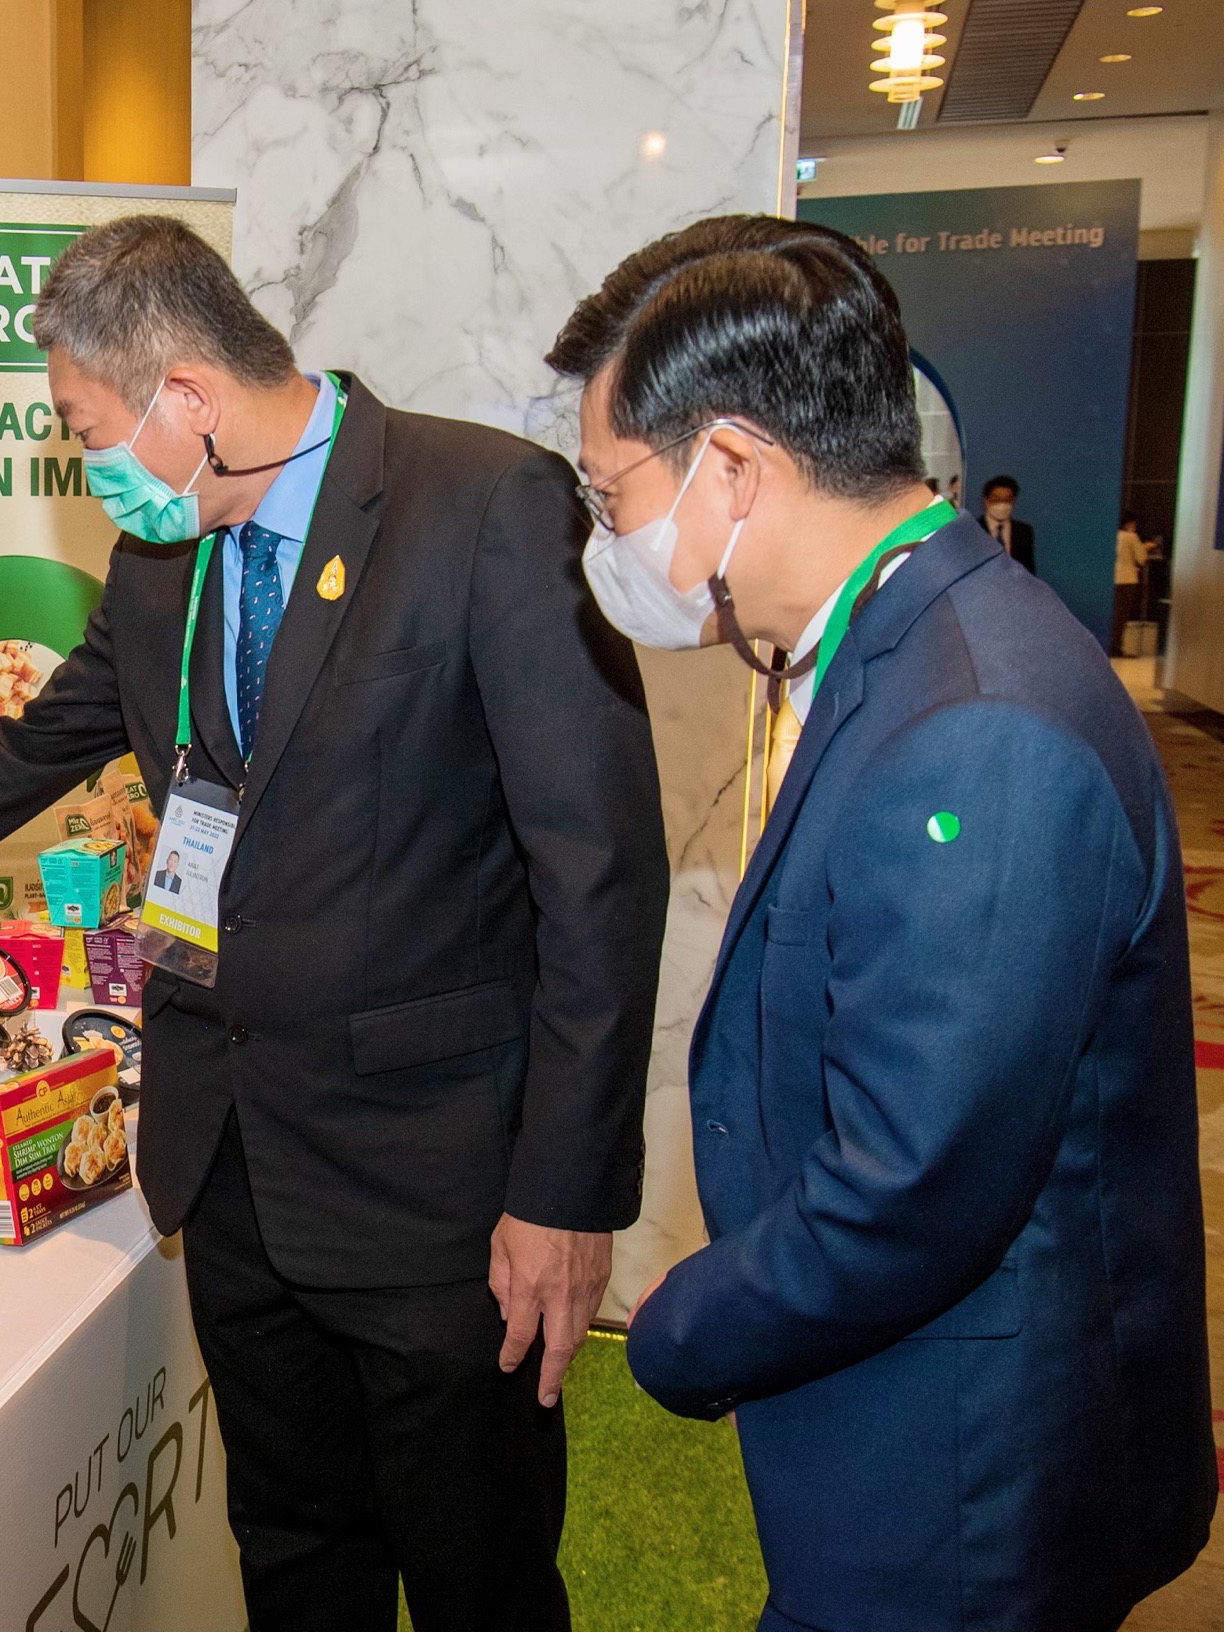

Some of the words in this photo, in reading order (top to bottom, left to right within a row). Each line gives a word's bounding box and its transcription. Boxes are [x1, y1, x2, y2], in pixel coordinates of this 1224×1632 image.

[895, 232, 931, 254] for
[938, 228, 1004, 251] Trade
[1009, 223, 1105, 248] Meeting
[30, 457, 91, 497] IM
[183, 836, 214, 855] THAILAND
[159, 912, 202, 939] EXHIBITOR
[38, 1086, 48, 1097] CP
[13, 1144, 37, 1159] SHRIMP
[37, 1132, 64, 1148] WONTON
[14, 1156, 28, 1167] DIM
[28, 1150, 42, 1160] SUM
[42, 1143, 56, 1155] TRAY
[54, 1432, 110, 1548] PUT
[116, 1366, 167, 1463] OUR
